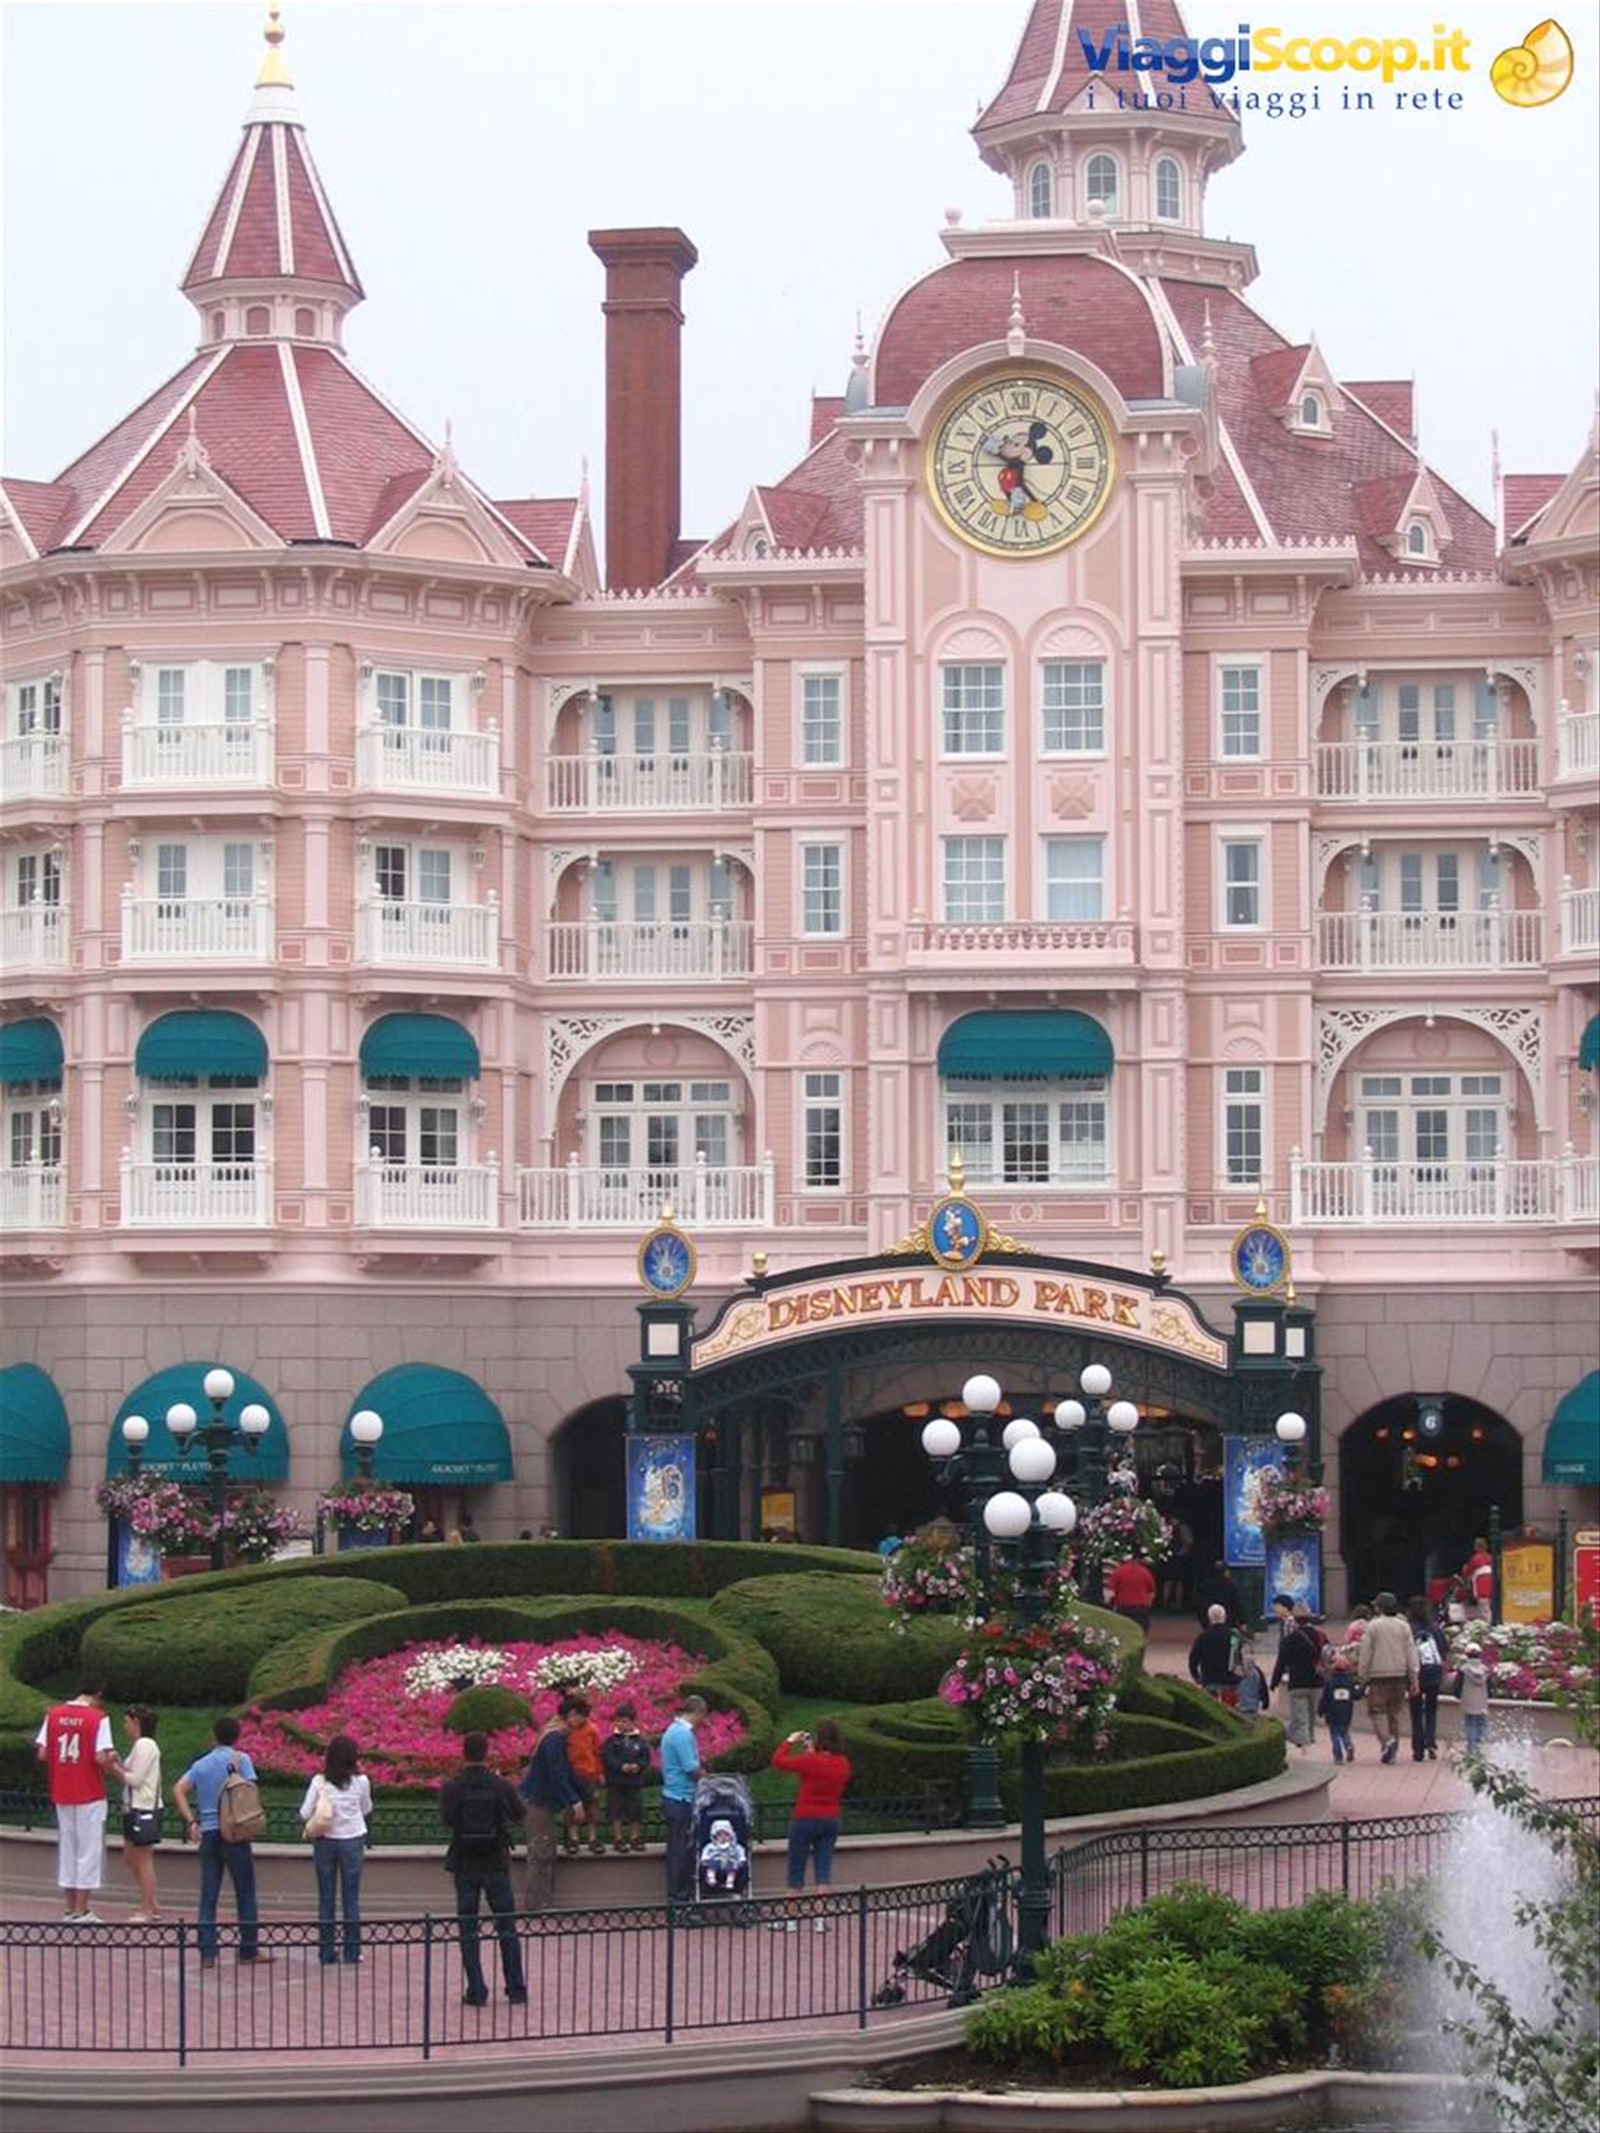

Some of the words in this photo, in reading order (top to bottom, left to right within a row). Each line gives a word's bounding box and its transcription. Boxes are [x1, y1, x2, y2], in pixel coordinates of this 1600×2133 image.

[768, 1276, 1020, 1331] DISNEYLAND
[1034, 1279, 1143, 1329] PARK
[57, 1733, 80, 1764] 14
